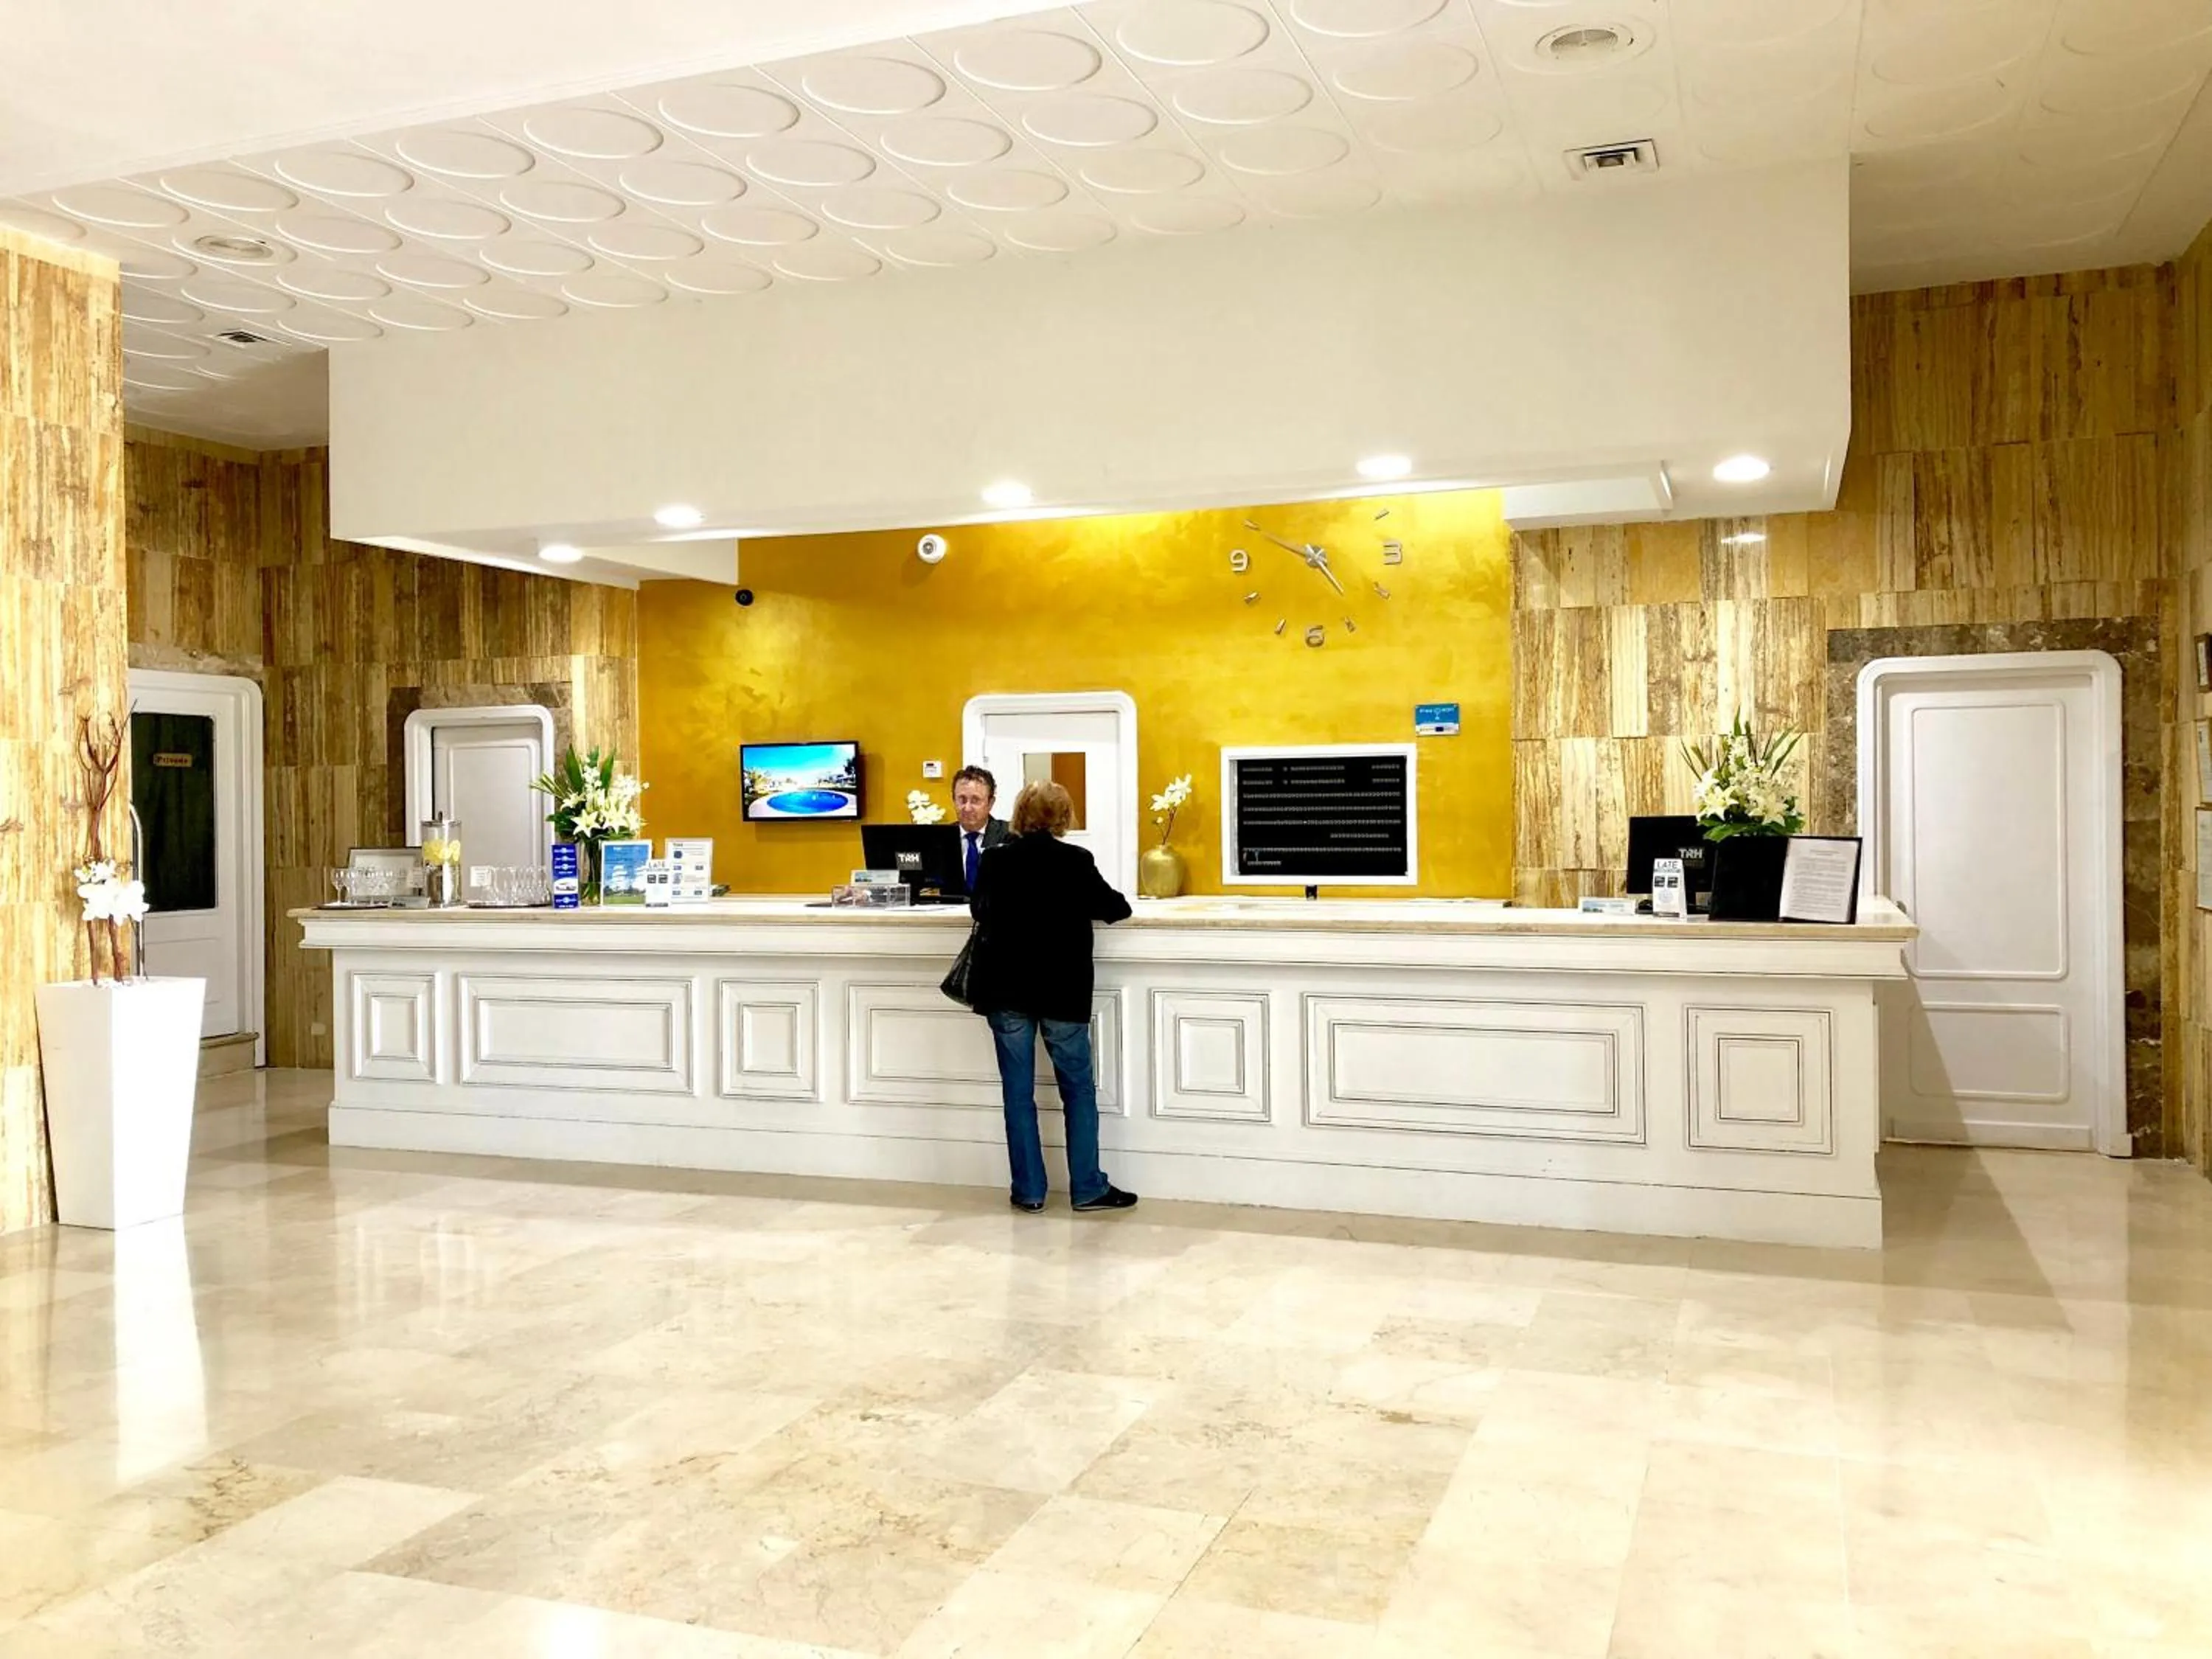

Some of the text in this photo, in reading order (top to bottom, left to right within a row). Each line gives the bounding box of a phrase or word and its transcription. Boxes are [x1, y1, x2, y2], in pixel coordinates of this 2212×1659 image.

[1229, 549, 1250, 572] 9
[1383, 540, 1402, 566] 3
[1304, 625, 1325, 647] 6
[897, 853, 919, 862] TRH
[1678, 848, 1703, 859] TRH
